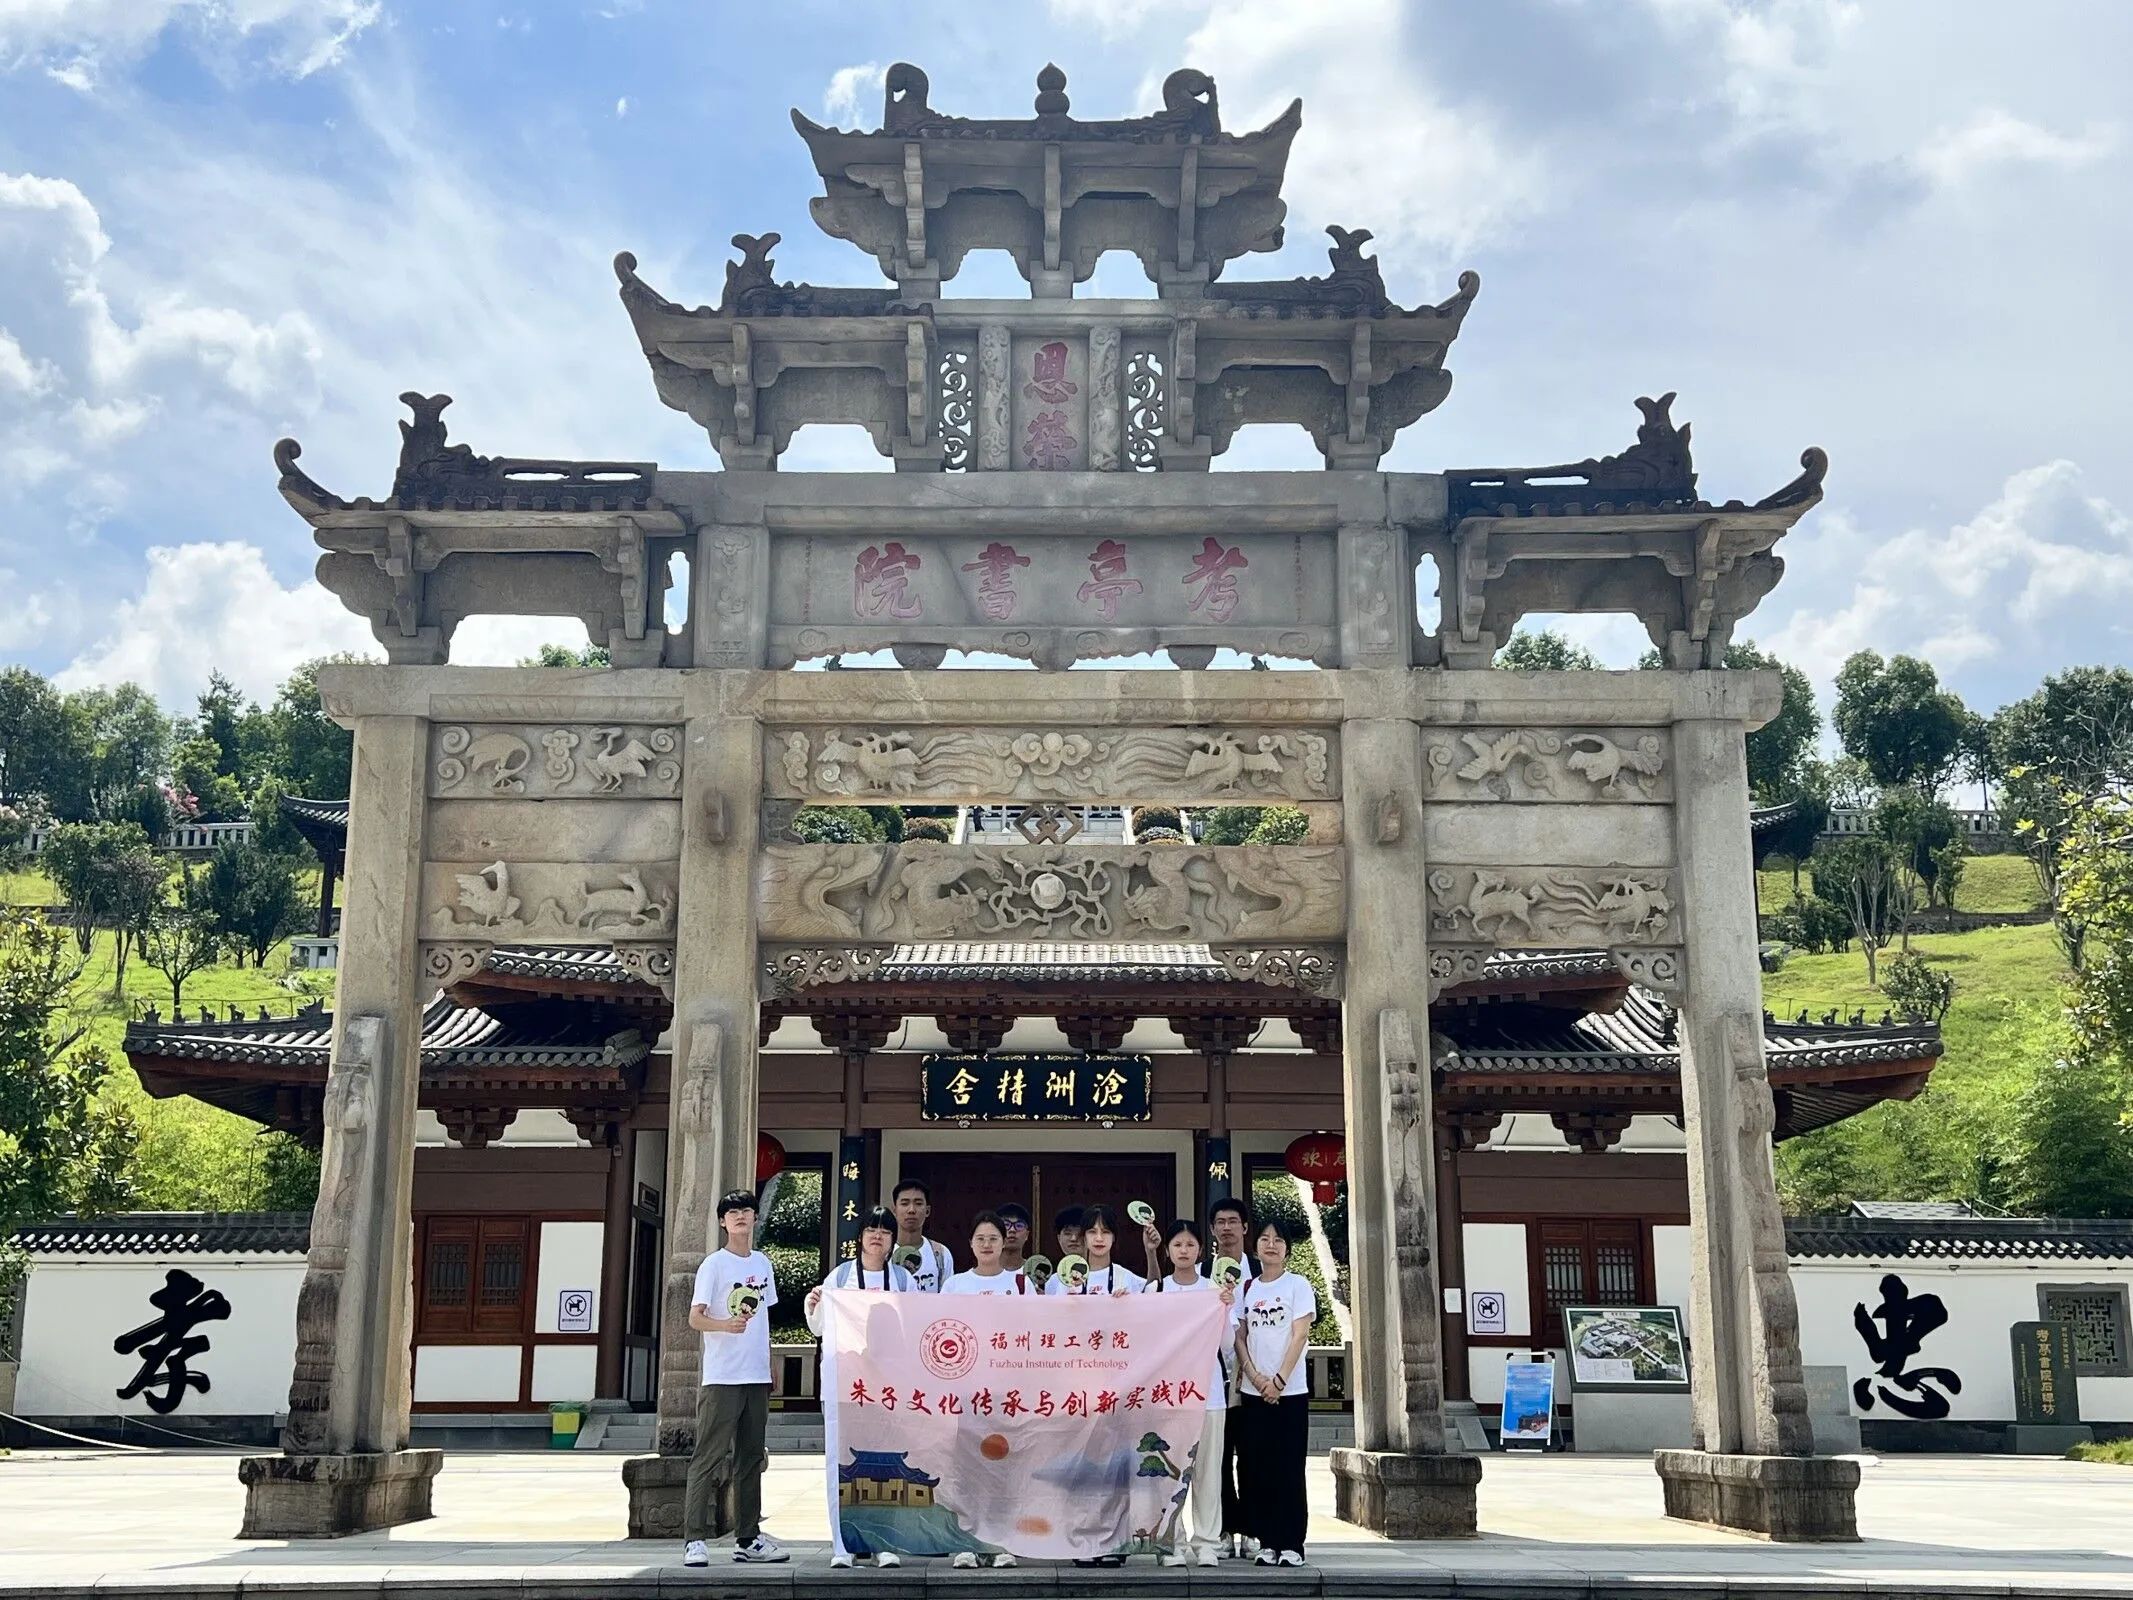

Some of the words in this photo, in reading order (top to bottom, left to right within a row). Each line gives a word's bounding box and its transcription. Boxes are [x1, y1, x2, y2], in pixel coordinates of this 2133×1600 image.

[113, 1268, 232, 1415] 孝
[989, 1329, 1130, 1352] 福州理工学院
[1853, 1273, 1962, 1420] 忠
[989, 1358, 1023, 1369] Fuzhou
[1026, 1358, 1062, 1369] Institute
[1064, 1358, 1075, 1369] of
[1077, 1358, 1129, 1370] Technology
[849, 1378, 1206, 1418] 朱子文化传承与创新实践队
